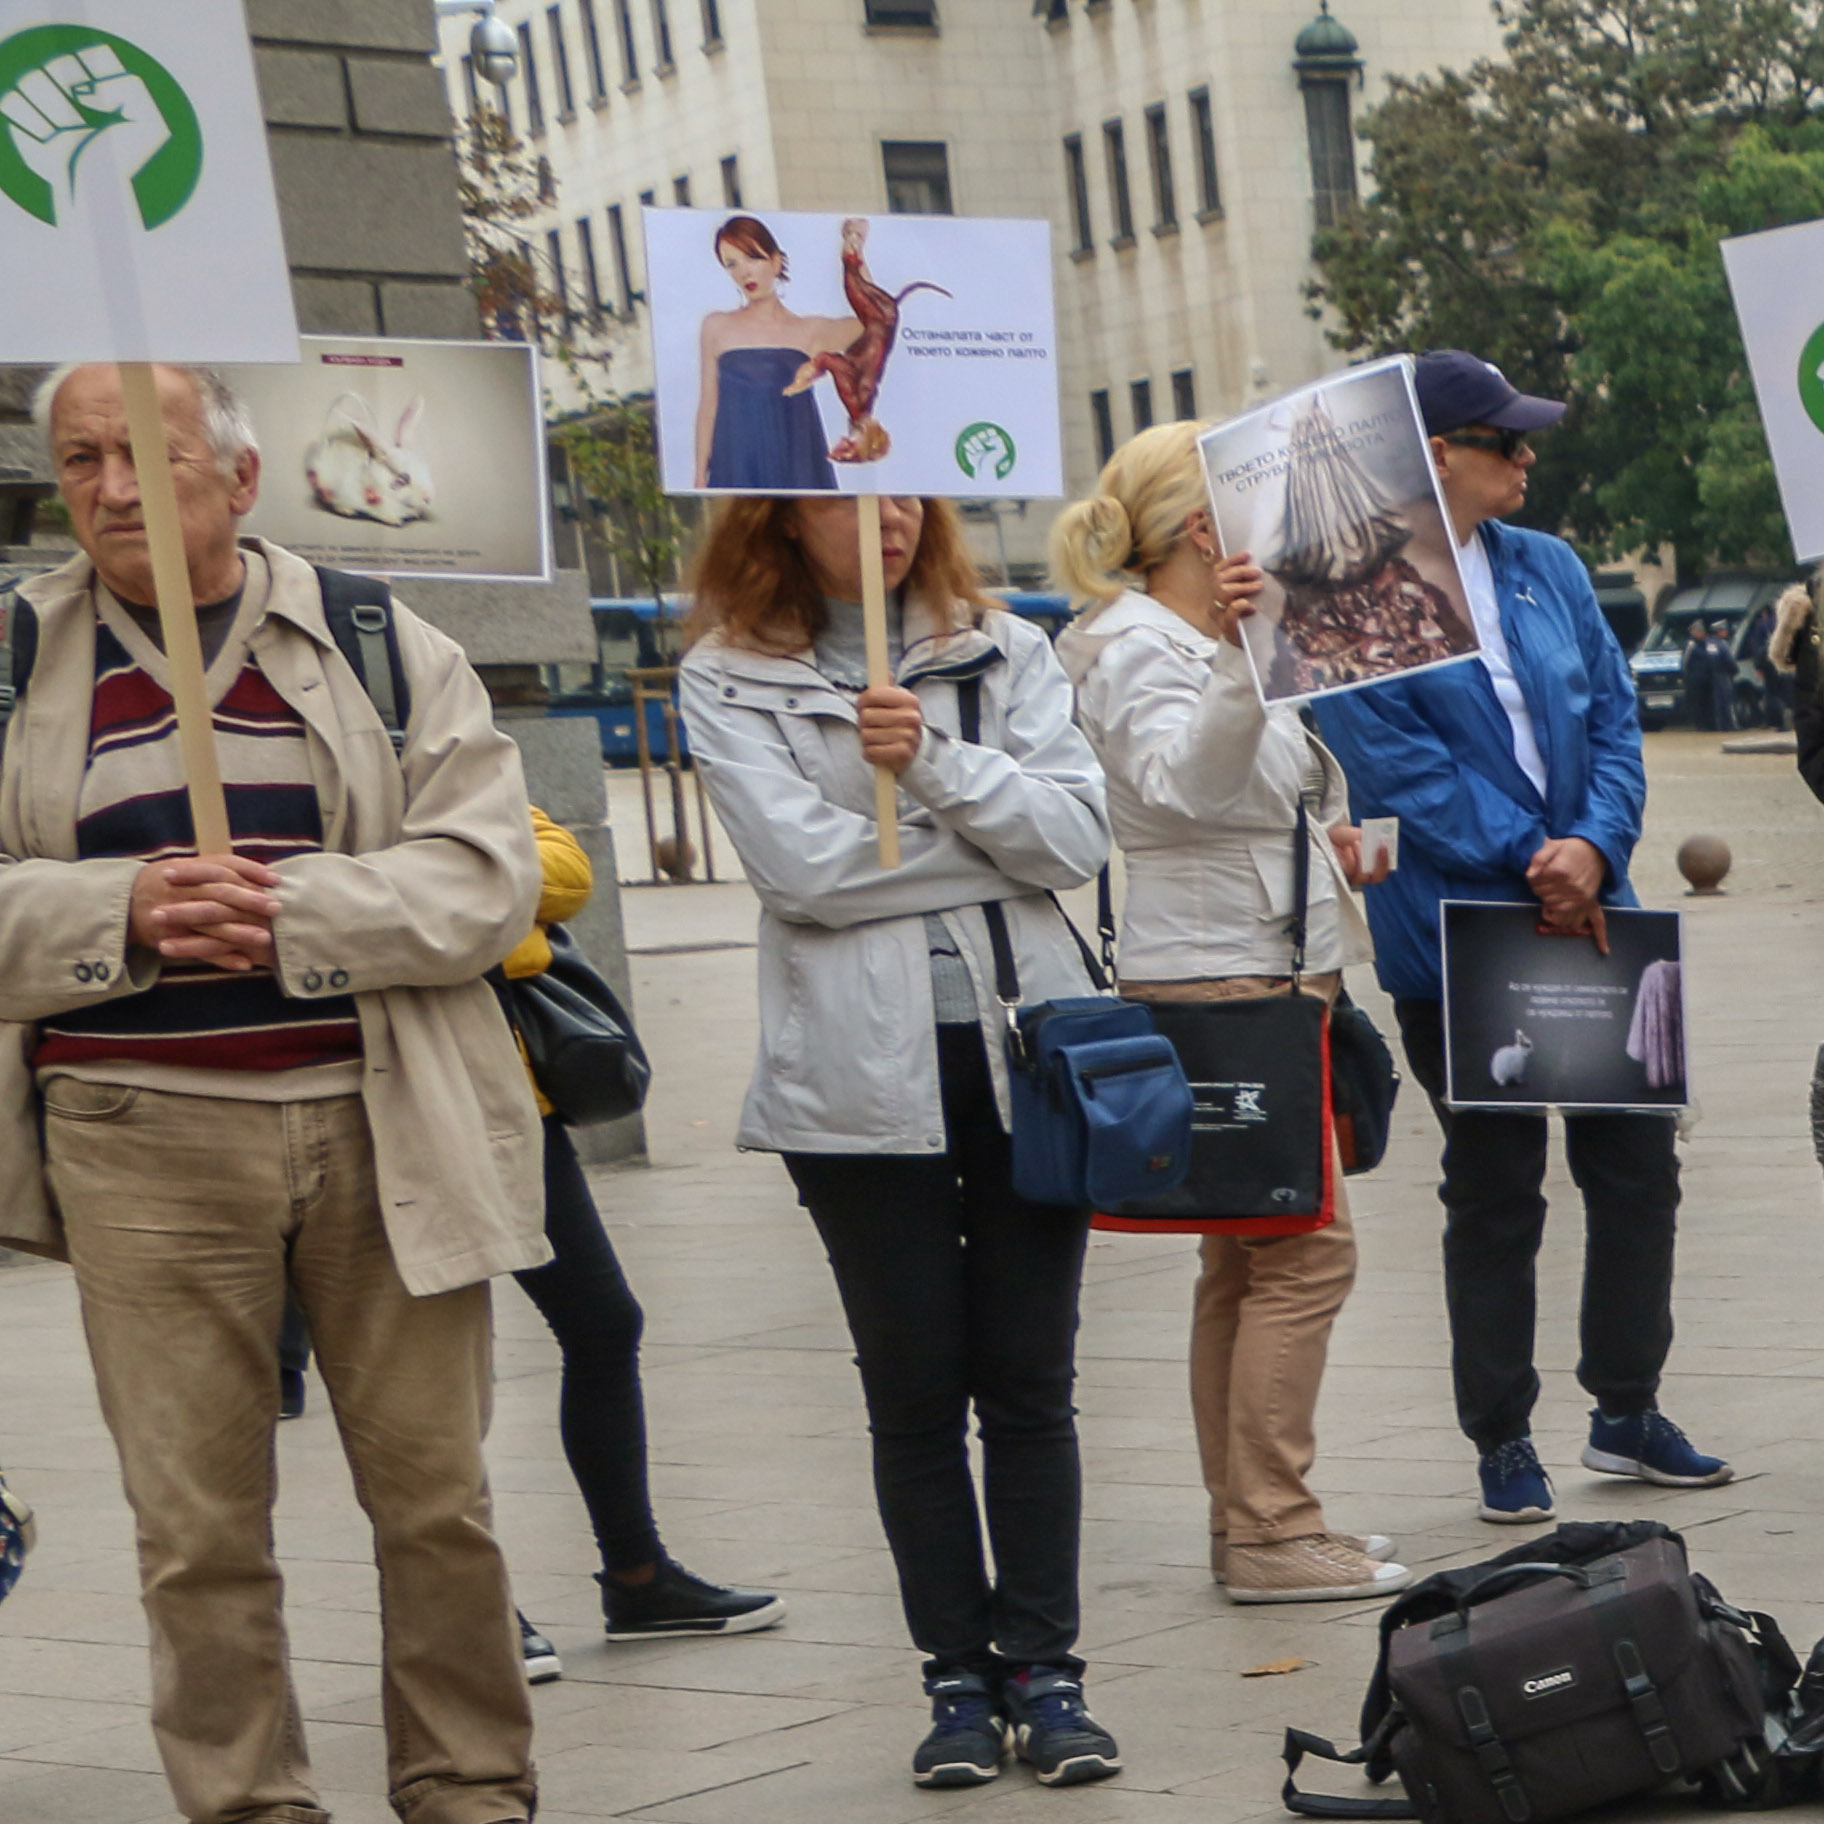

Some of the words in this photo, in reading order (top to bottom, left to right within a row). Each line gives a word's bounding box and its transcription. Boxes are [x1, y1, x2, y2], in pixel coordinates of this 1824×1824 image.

[901, 326, 982, 341] Останалата
[985, 331, 1015, 342] част
[1019, 332, 1034, 342] от
[906, 346, 952, 357] твоето
[955, 346, 1005, 358] кожено
[1007, 348, 1048, 359] палто
[1217, 450, 1275, 485] ТВОЕТО
[1524, 1672, 1572, 1693] Canon
